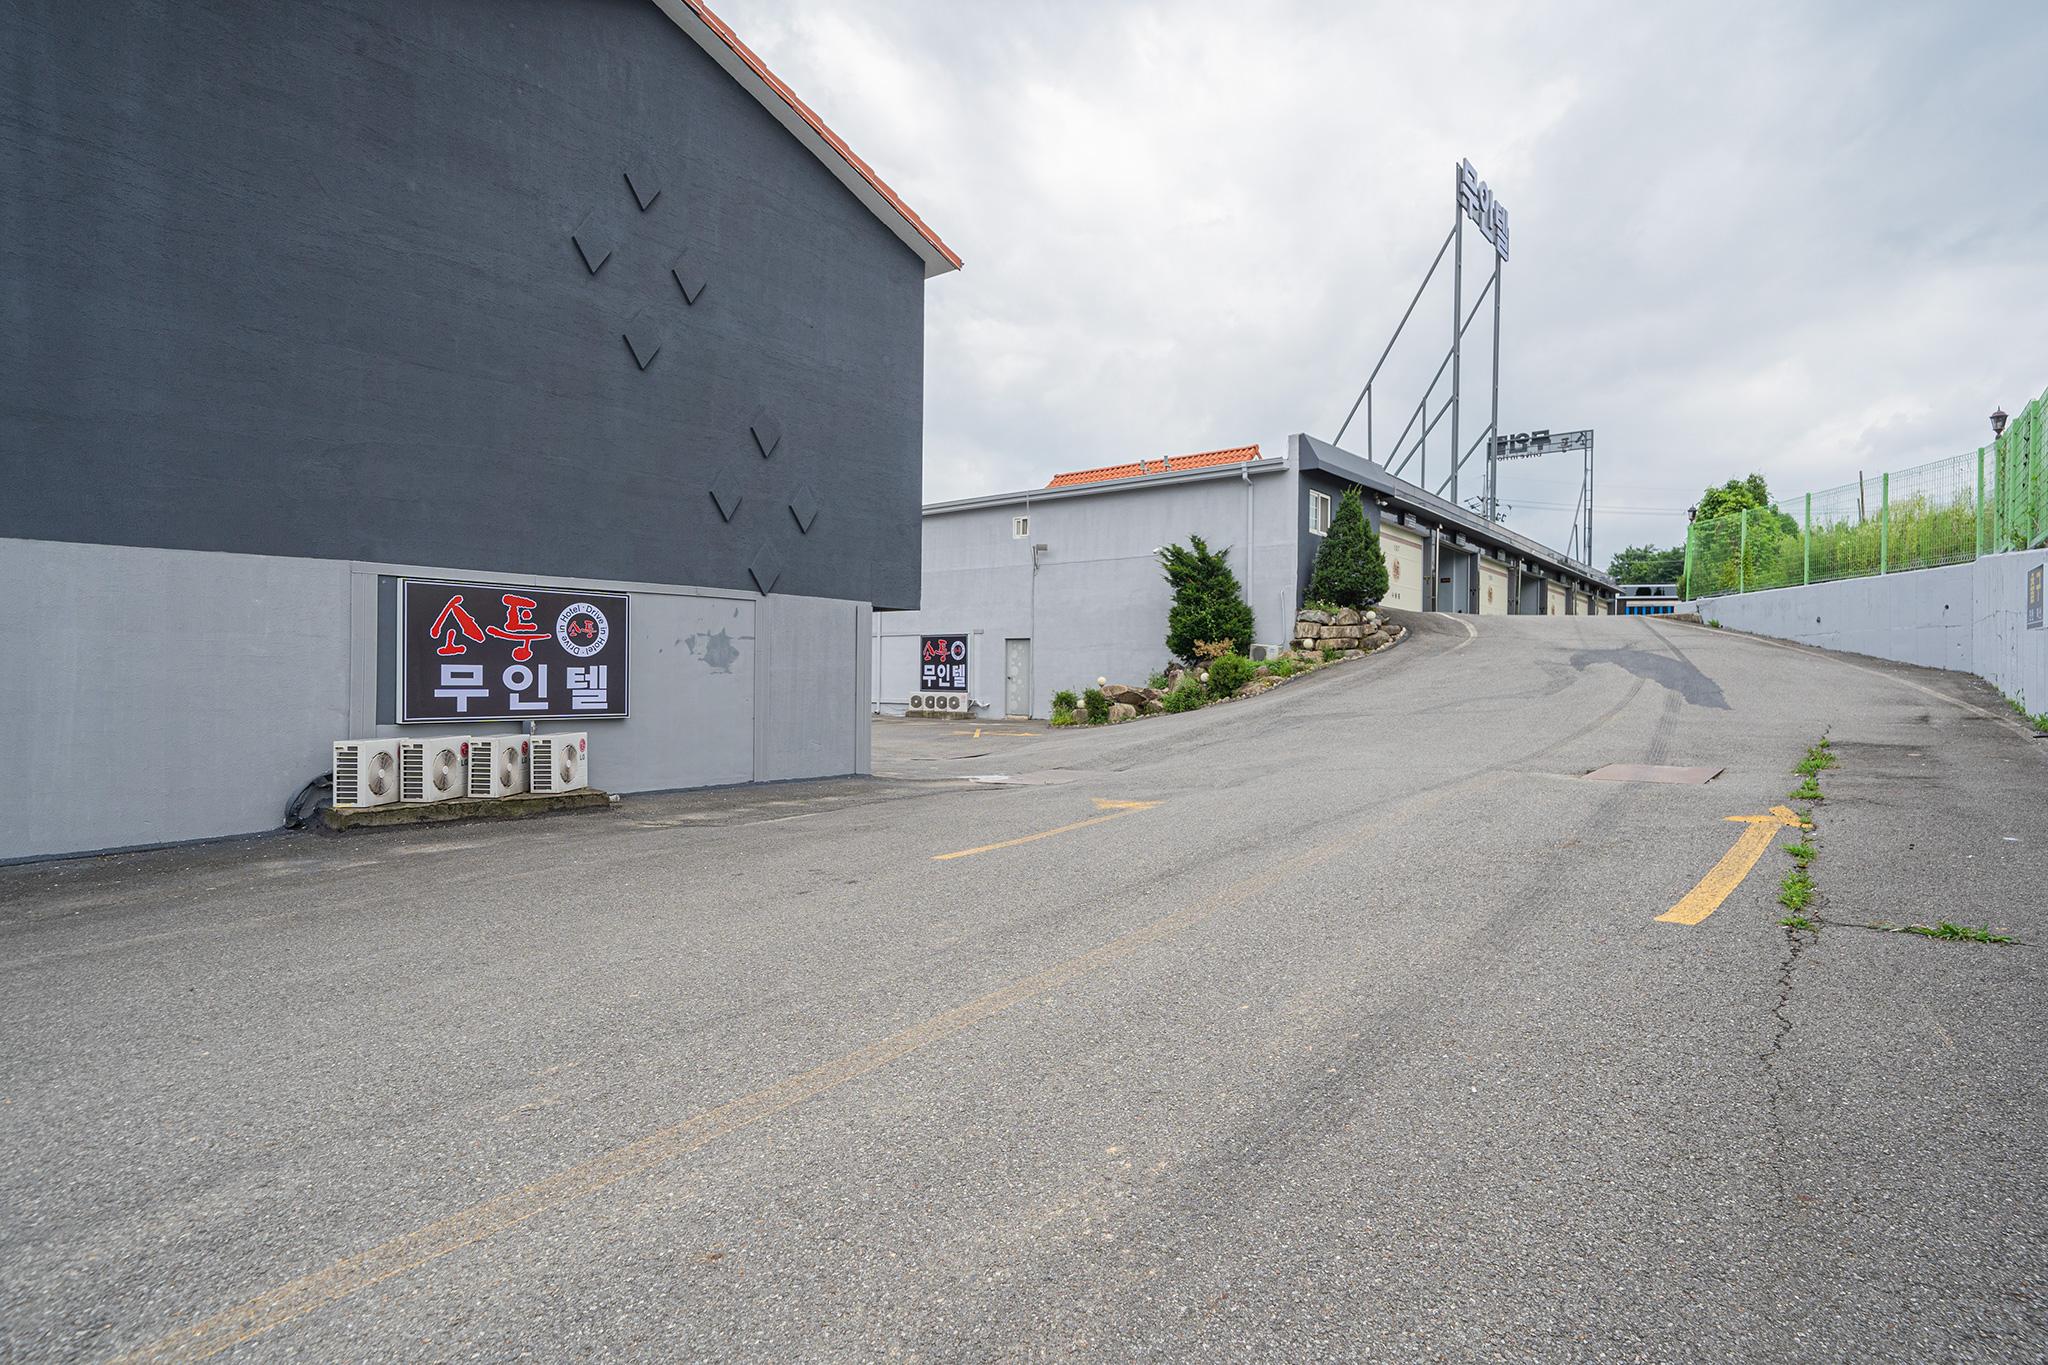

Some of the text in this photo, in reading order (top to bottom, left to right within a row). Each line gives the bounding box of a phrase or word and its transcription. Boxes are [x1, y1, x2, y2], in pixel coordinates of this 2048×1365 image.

[430, 594, 551, 661] 소풍
[558, 605, 580, 655] Drive in Hotel
[586, 605, 607, 655] Drive in Hotel
[434, 664, 608, 713] 무인텔
[923, 664, 966, 687] 무인텔
